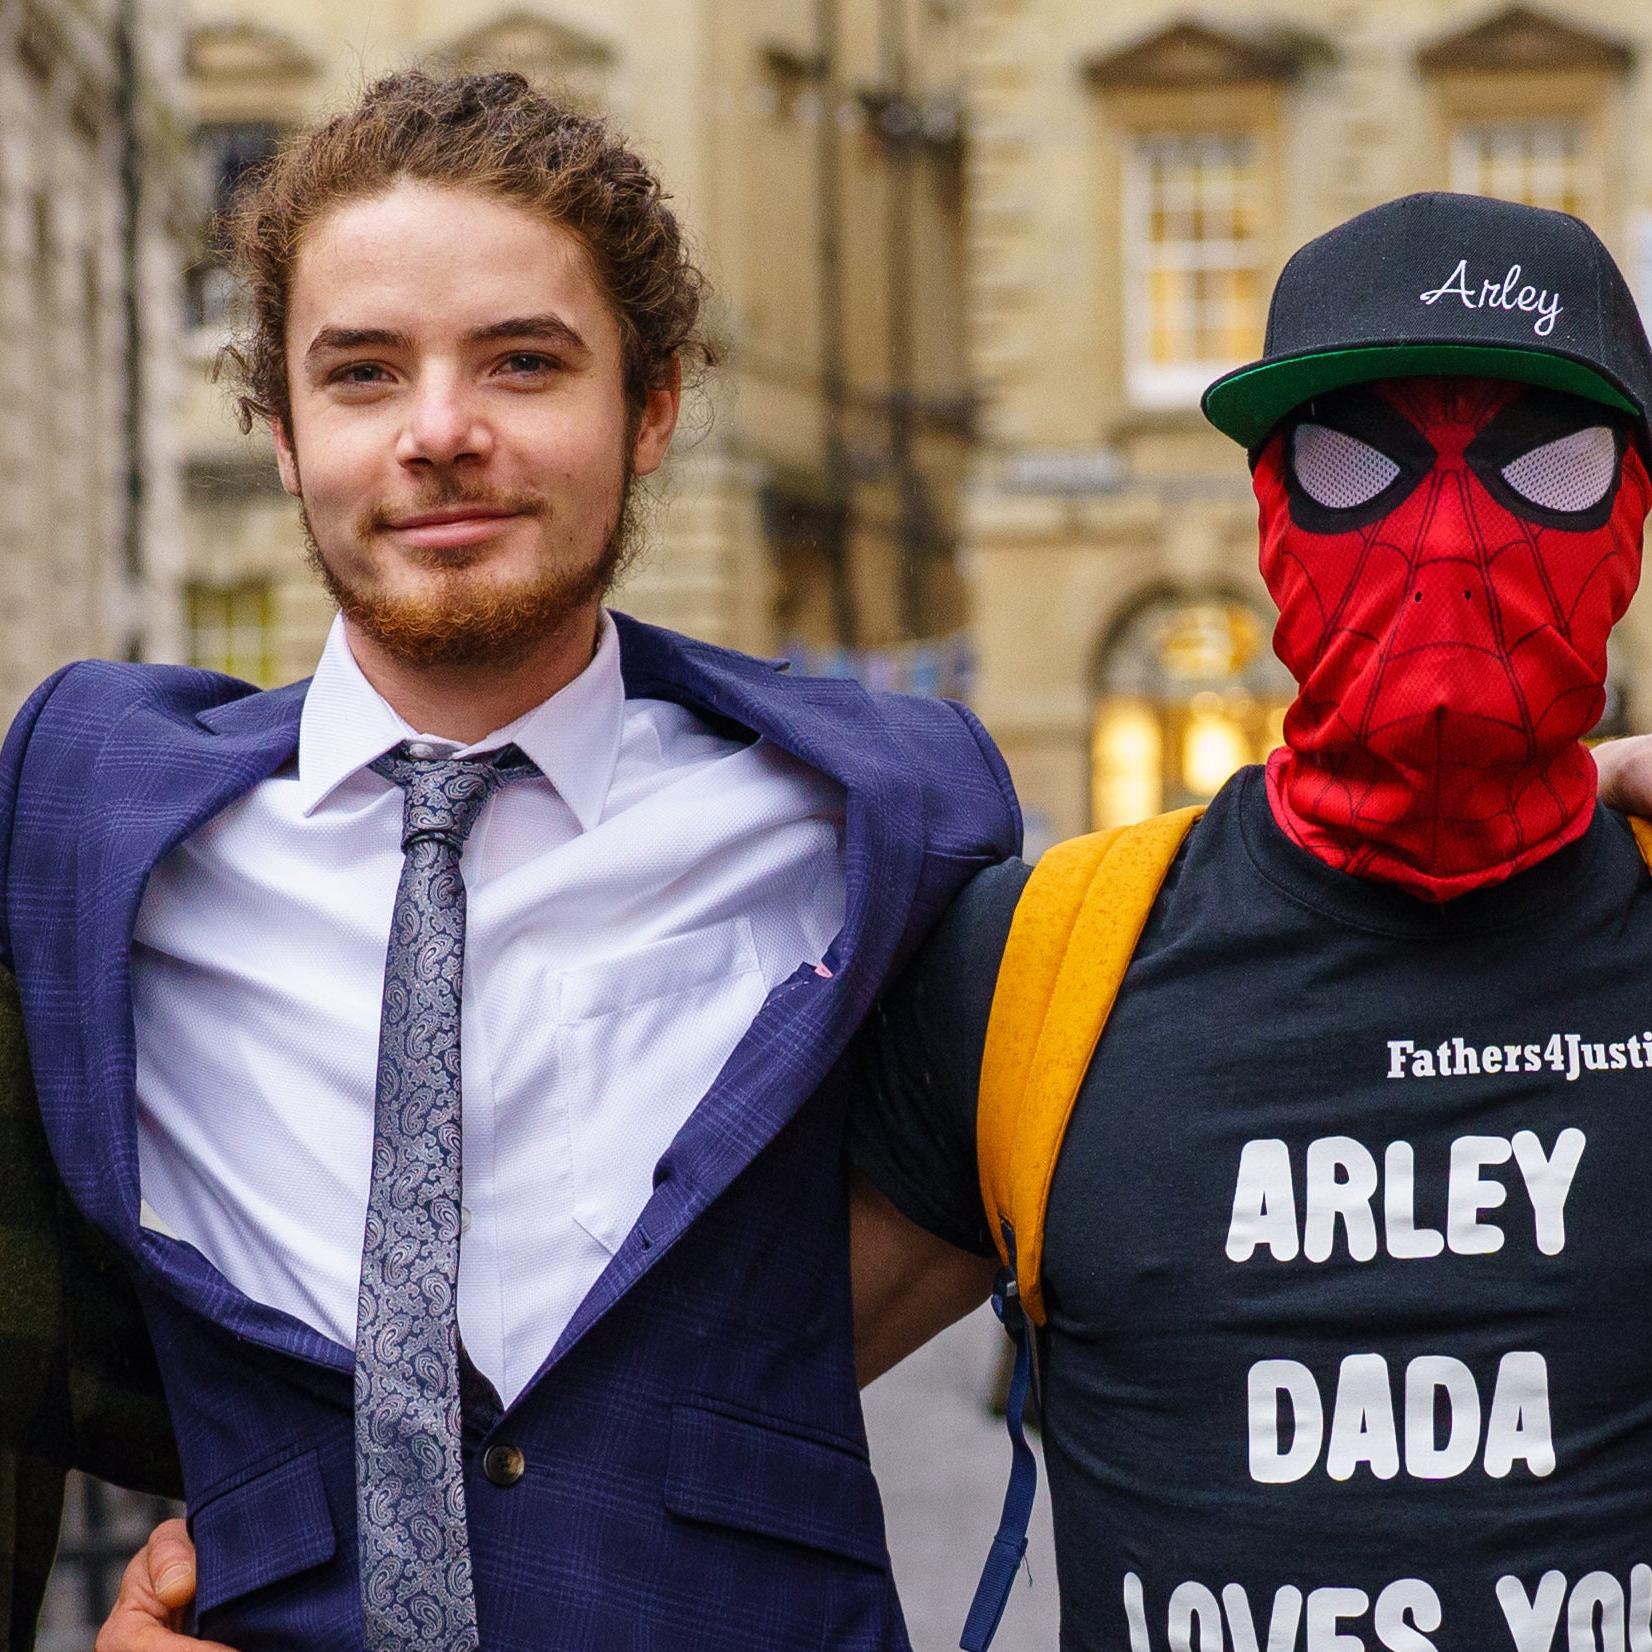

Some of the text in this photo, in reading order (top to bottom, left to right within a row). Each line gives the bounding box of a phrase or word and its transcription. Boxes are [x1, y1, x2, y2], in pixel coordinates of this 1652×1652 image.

[1419, 259, 1564, 337] Arley
[1224, 1127, 1587, 1264] ARLEY
[1247, 1351, 1557, 1484] DADA
